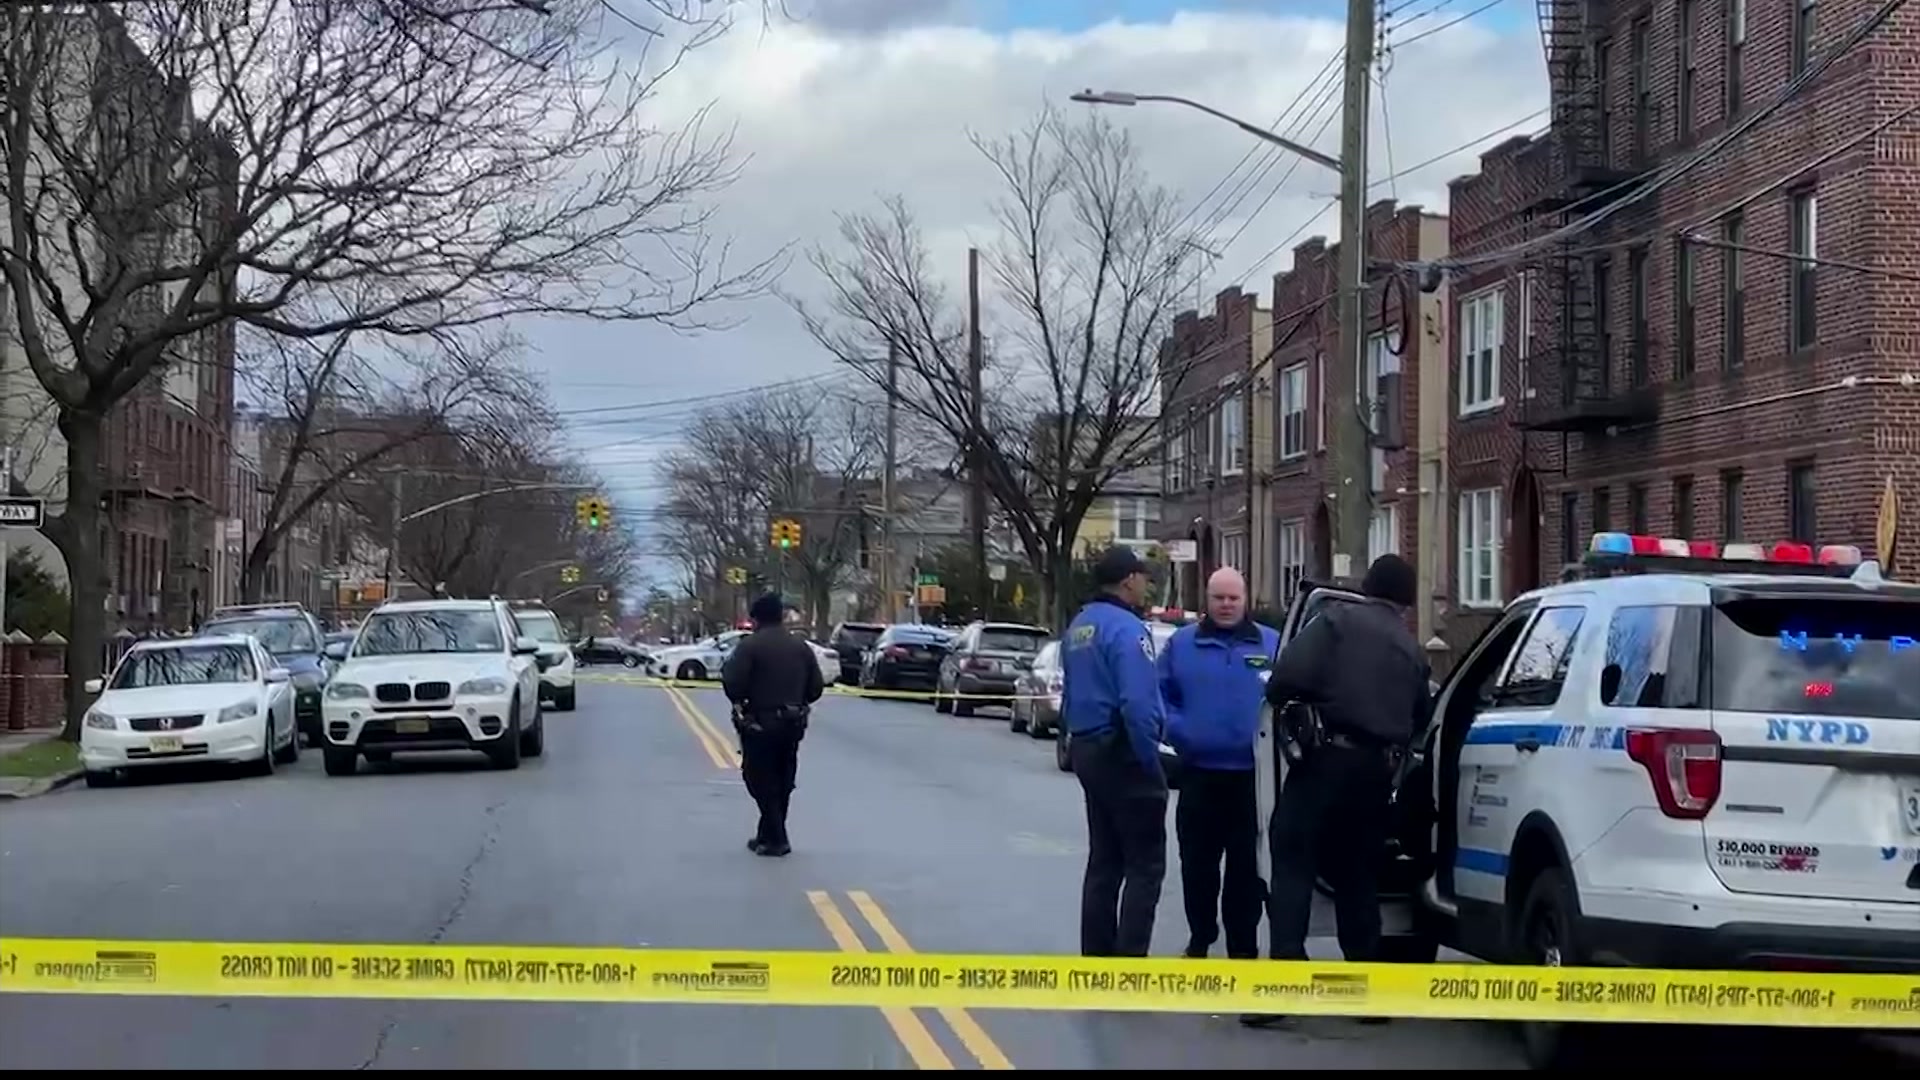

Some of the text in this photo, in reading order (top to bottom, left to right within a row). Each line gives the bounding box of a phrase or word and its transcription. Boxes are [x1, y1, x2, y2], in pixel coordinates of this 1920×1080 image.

[1766, 718, 1870, 745] NYPD
[1717, 839, 1820, 857] $10,000 REWARD
